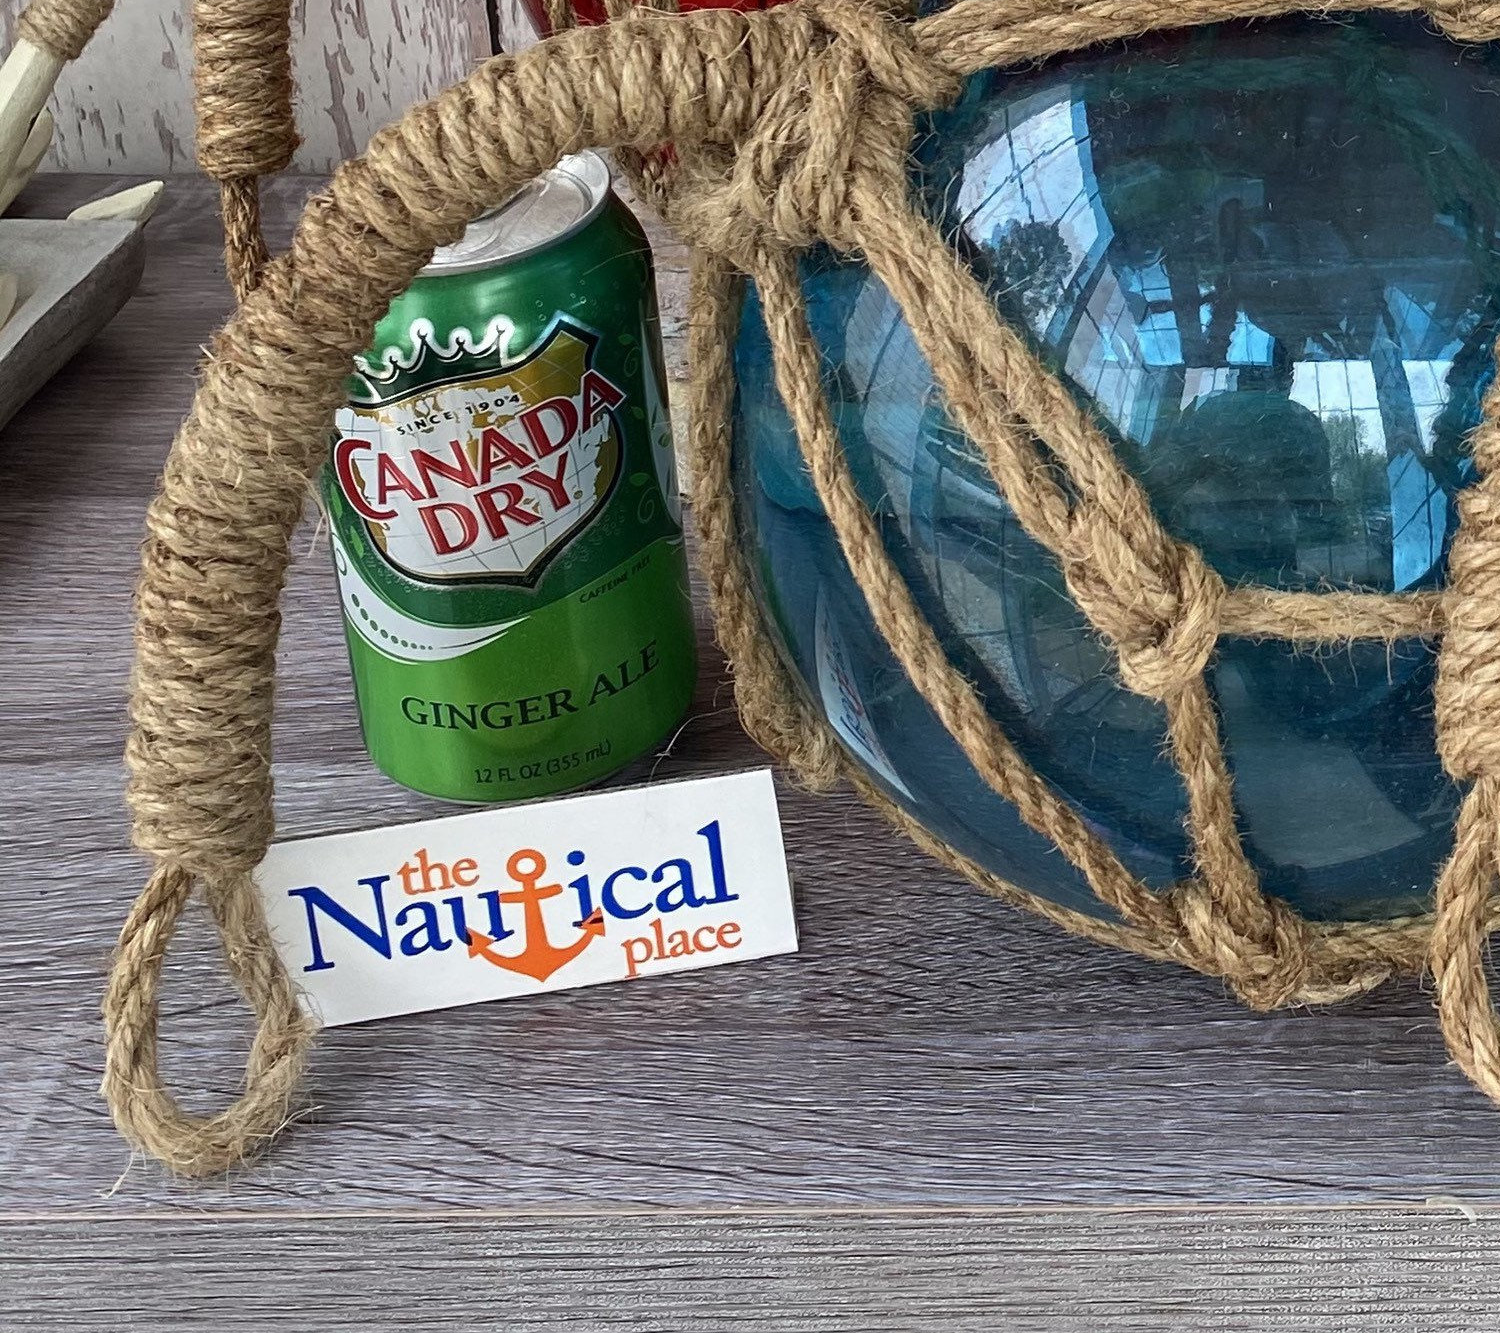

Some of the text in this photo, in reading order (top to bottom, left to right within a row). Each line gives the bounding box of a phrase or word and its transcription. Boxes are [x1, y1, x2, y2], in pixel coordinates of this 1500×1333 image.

[334, 368, 626, 521] CANADA
[396, 394, 520, 435] SINCE 1904
[418, 451, 571, 556] DRY
[401, 639, 660, 730] GINGER ALE
[475, 769, 493, 783] 12
[498, 768, 516, 782] FL
[519, 763, 542, 780] OZ
[546, 751, 580, 776] (355
[396, 848, 480, 896] the
[621, 919, 743, 980] place
